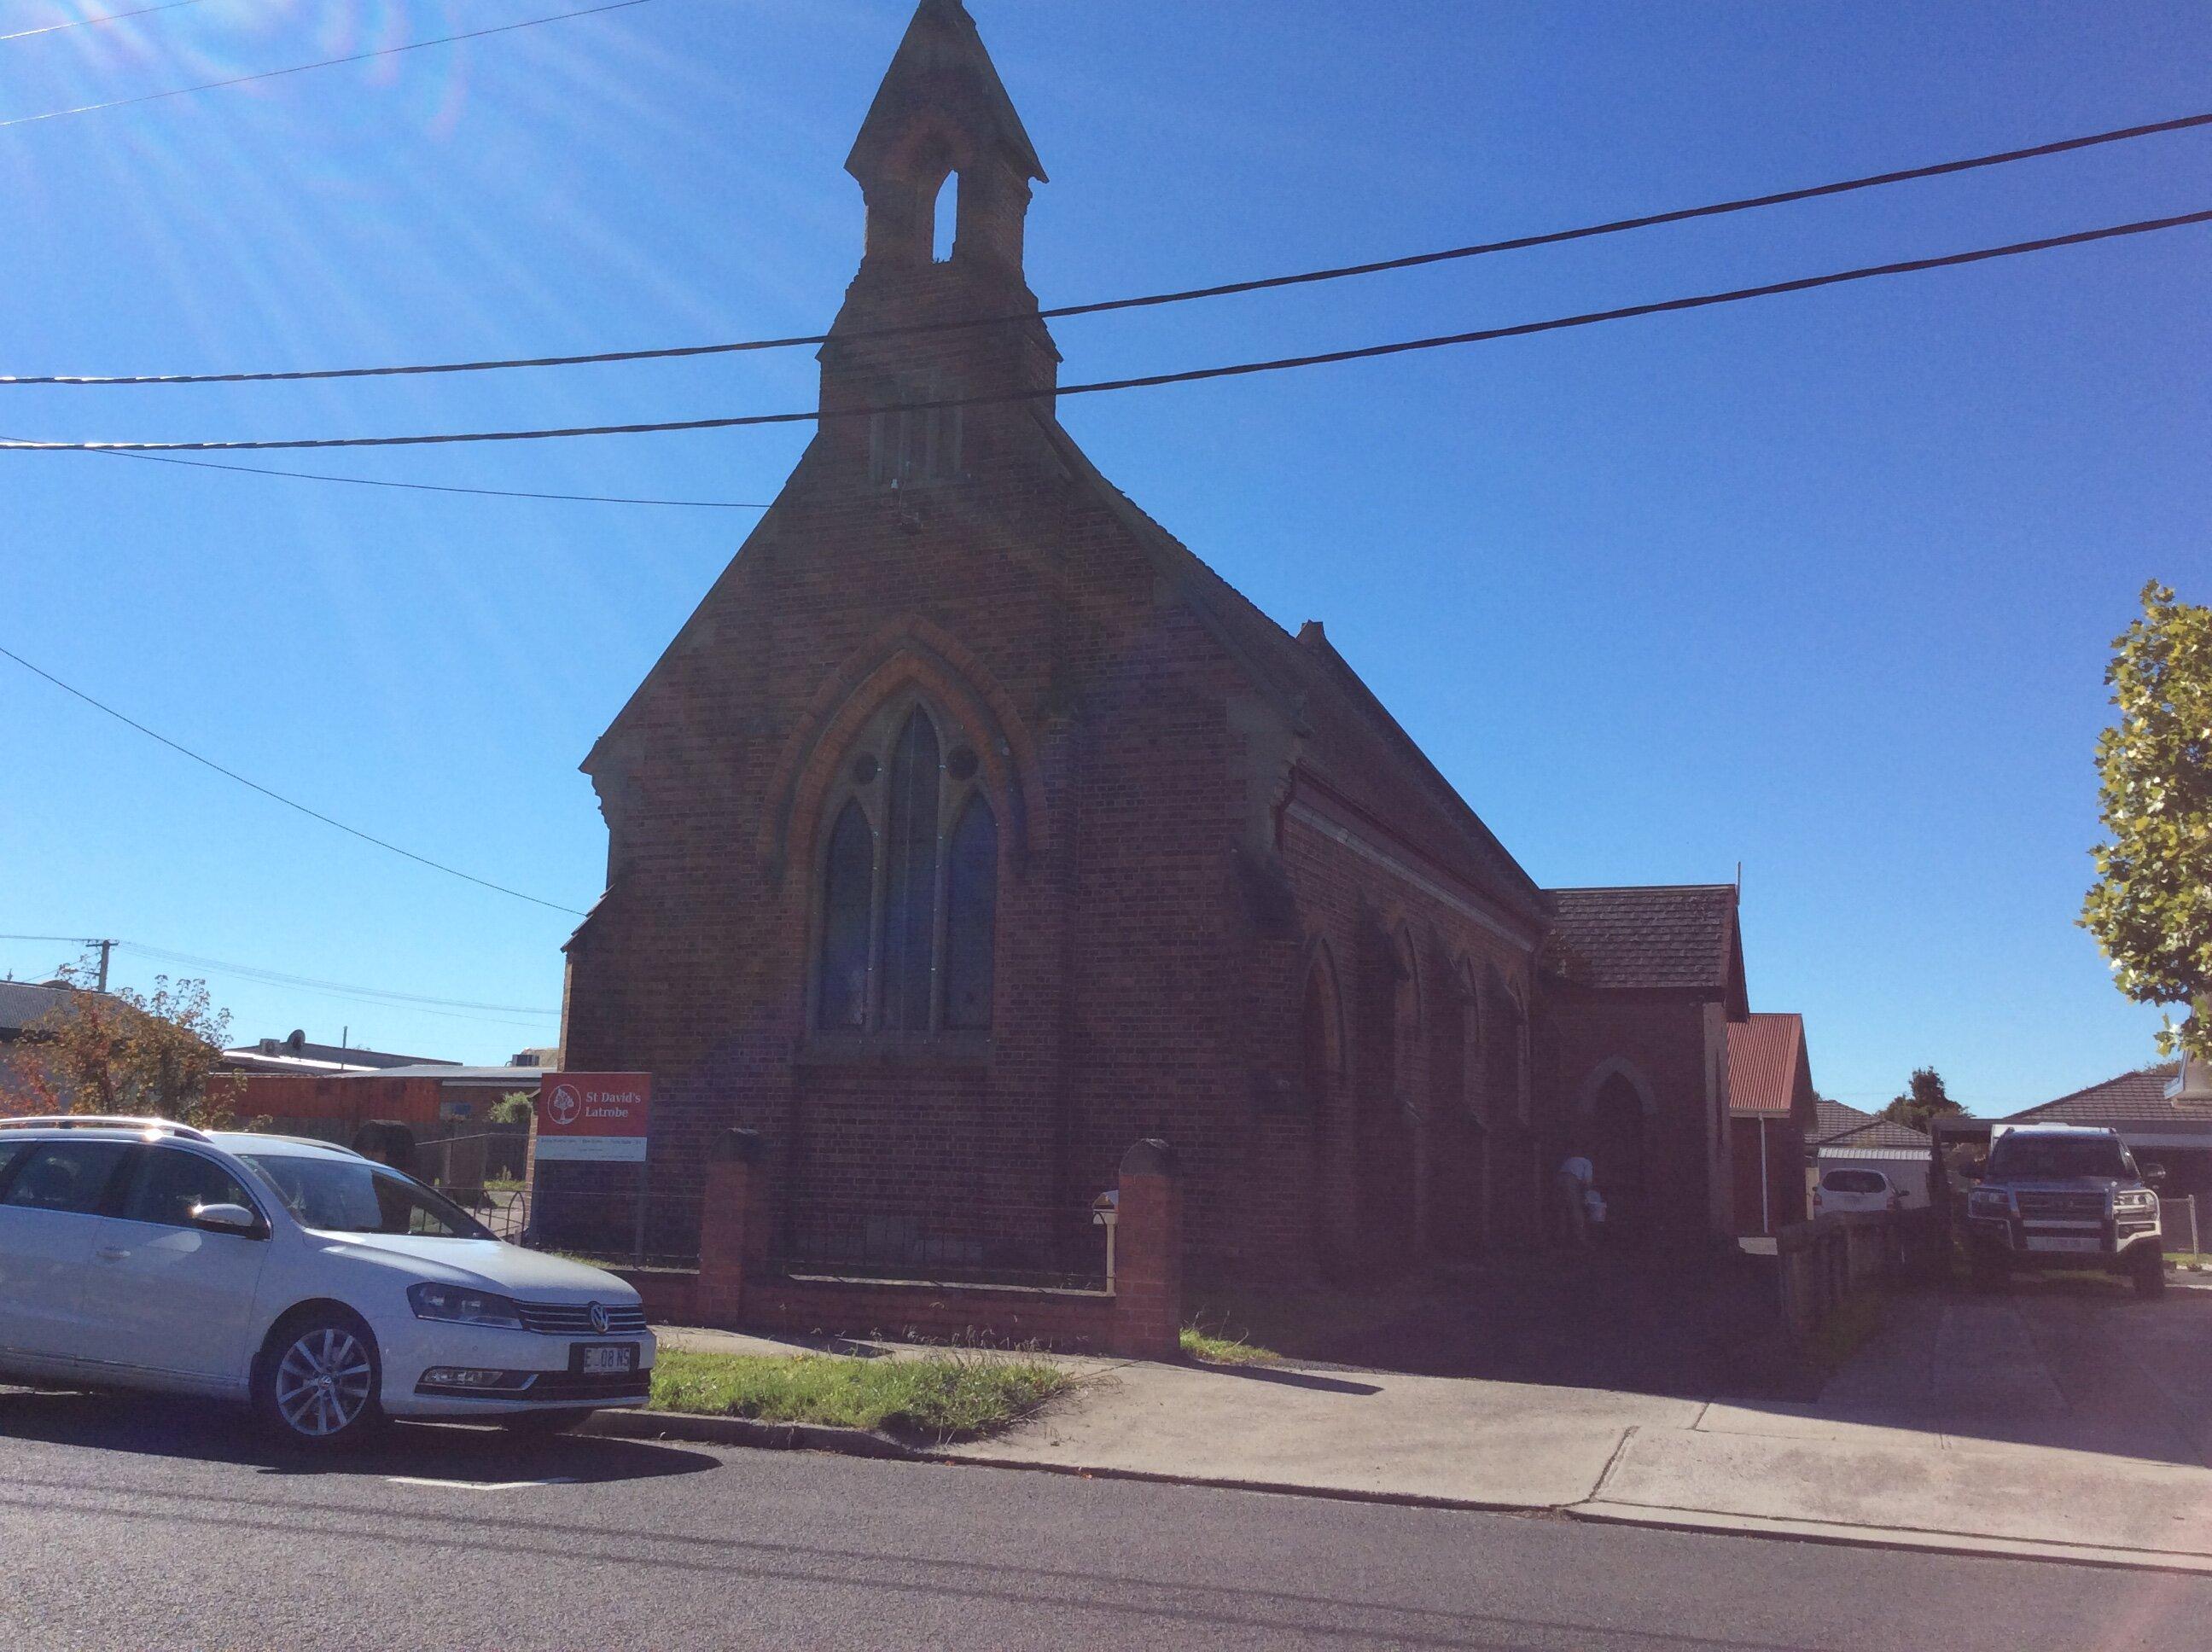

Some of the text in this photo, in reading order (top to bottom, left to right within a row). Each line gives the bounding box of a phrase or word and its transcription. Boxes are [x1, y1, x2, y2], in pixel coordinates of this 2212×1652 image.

[586, 1091, 641, 1103] St David's
[585, 1107, 628, 1118] Latrobe
